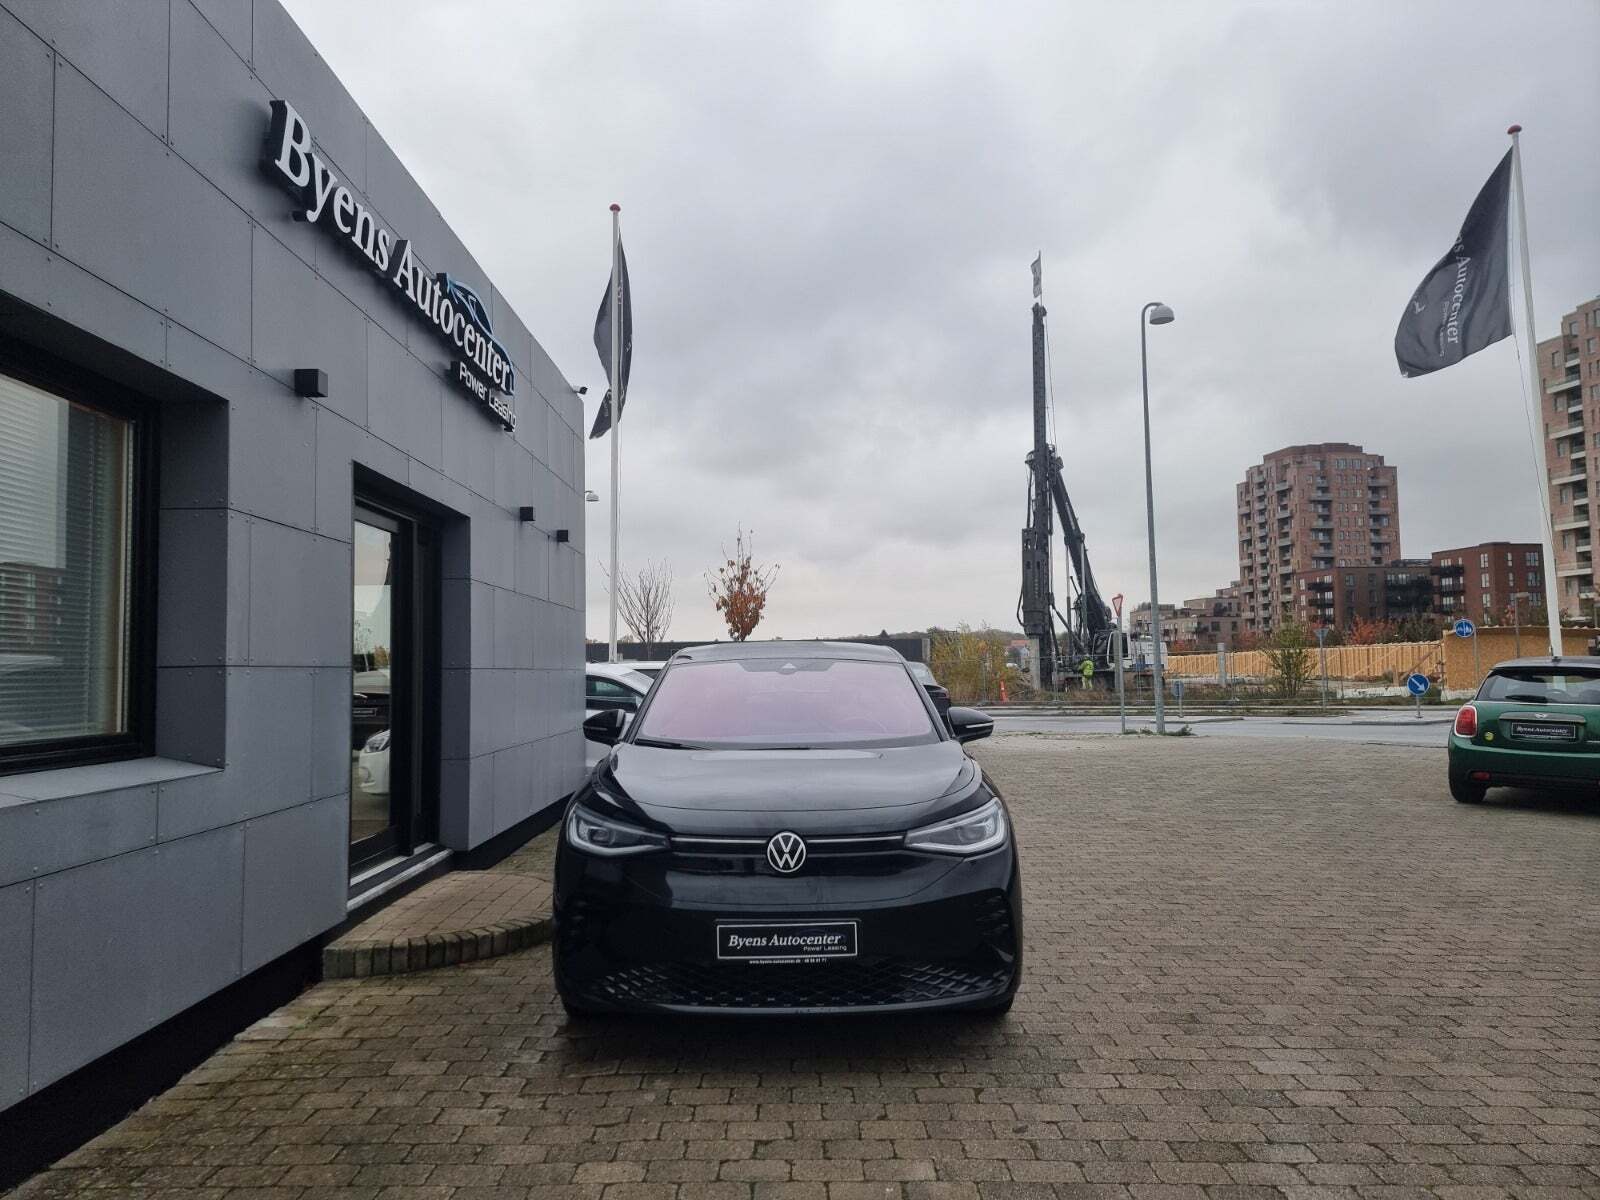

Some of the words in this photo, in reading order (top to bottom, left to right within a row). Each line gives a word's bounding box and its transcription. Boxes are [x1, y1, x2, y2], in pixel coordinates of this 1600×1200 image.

[274, 99, 390, 272] Byens
[393, 239, 511, 392] Autocenter
[1447, 256, 1471, 344] Autocenter
[459, 361, 487, 401] Power
[488, 388, 517, 433] Leasing
[769, 833, 804, 870] VW
[727, 934, 767, 950] Byens
[768, 932, 842, 947] Autocenter
